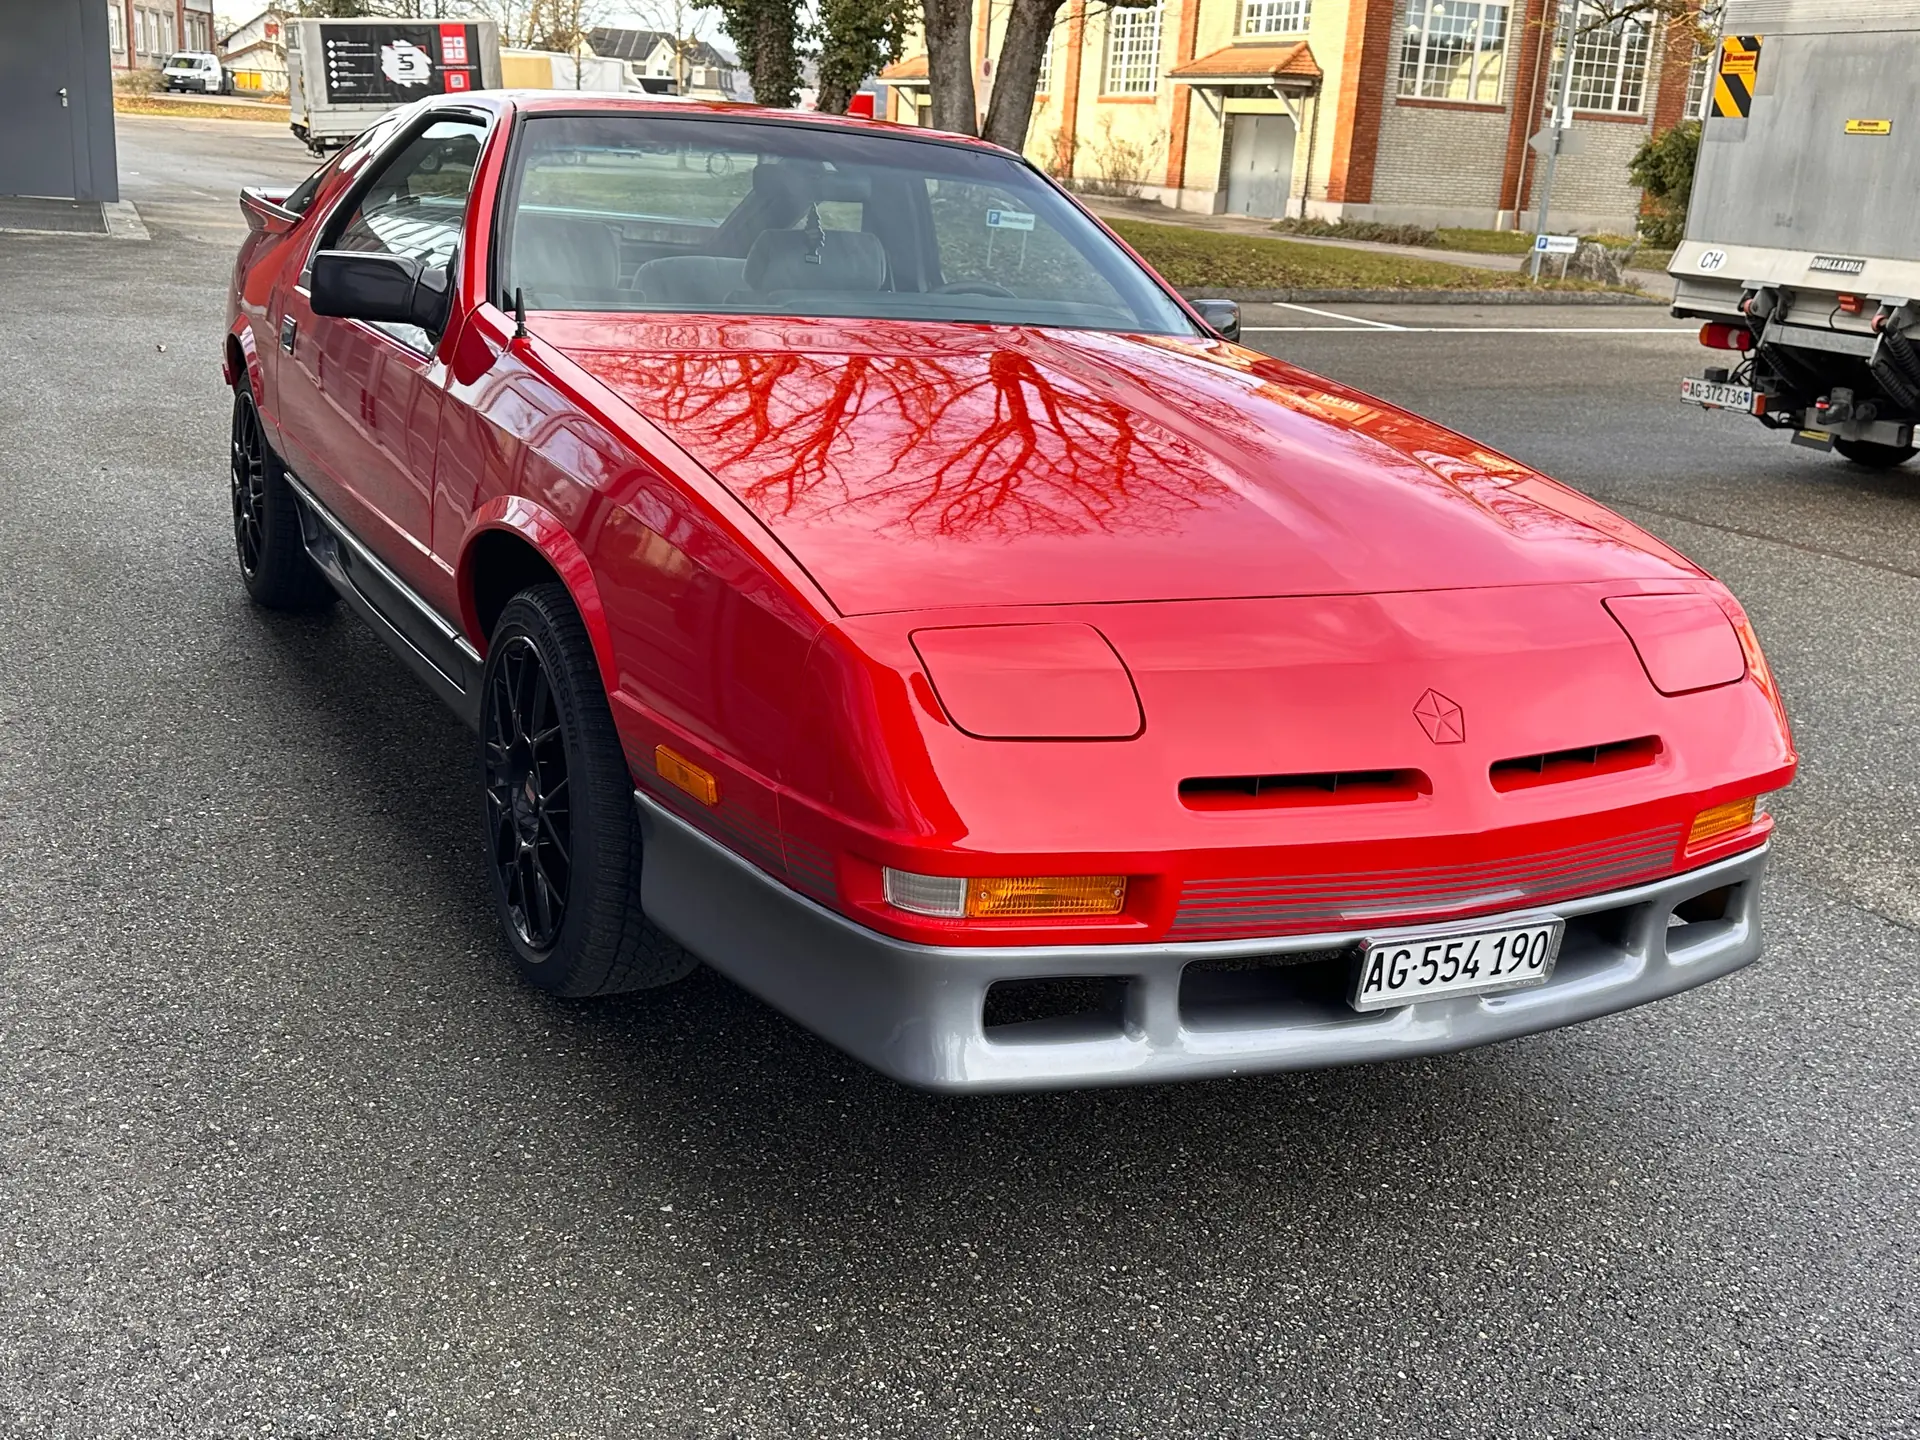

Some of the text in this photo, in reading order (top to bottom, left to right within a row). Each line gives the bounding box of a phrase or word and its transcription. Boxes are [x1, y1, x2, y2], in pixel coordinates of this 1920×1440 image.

[1700, 251, 1724, 268] CH
[1810, 258, 1863, 273] DHOLLANDIA
[538, 626, 579, 754] BRIDGESTONE
[1490, 930, 1549, 977] 190
